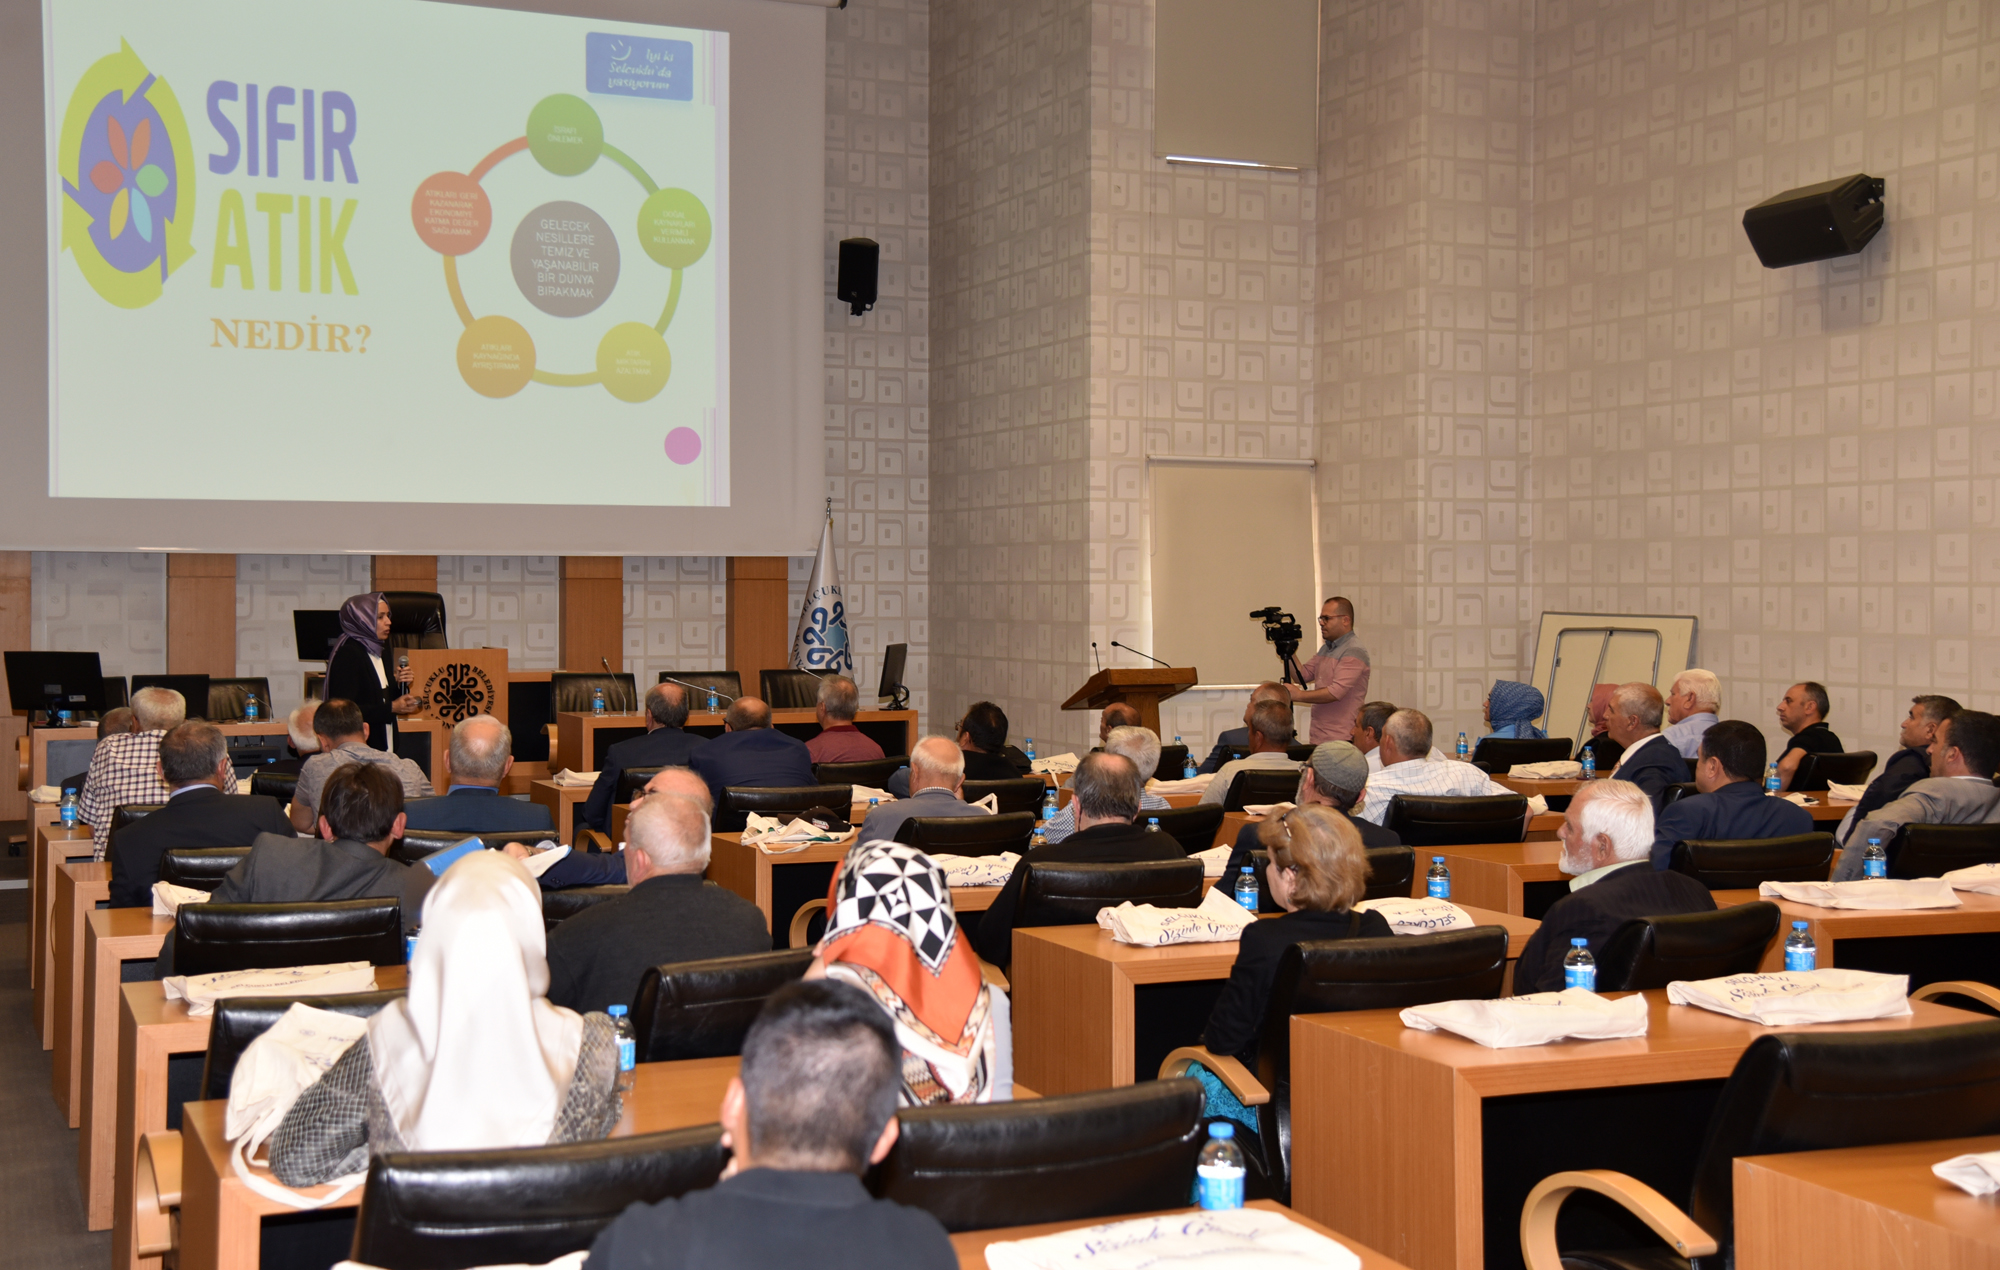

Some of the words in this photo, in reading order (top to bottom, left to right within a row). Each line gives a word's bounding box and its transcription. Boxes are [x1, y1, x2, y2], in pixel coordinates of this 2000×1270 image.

[206, 80, 359, 184] SIFIR
[210, 188, 360, 296] ATIK
[540, 218, 591, 232] GELECEK
[576, 247, 590, 259] VE
[537, 285, 594, 298] BIRAKMAK
[210, 314, 372, 354] NEDİR?
[422, 666, 445, 711] SELÇUKLU
